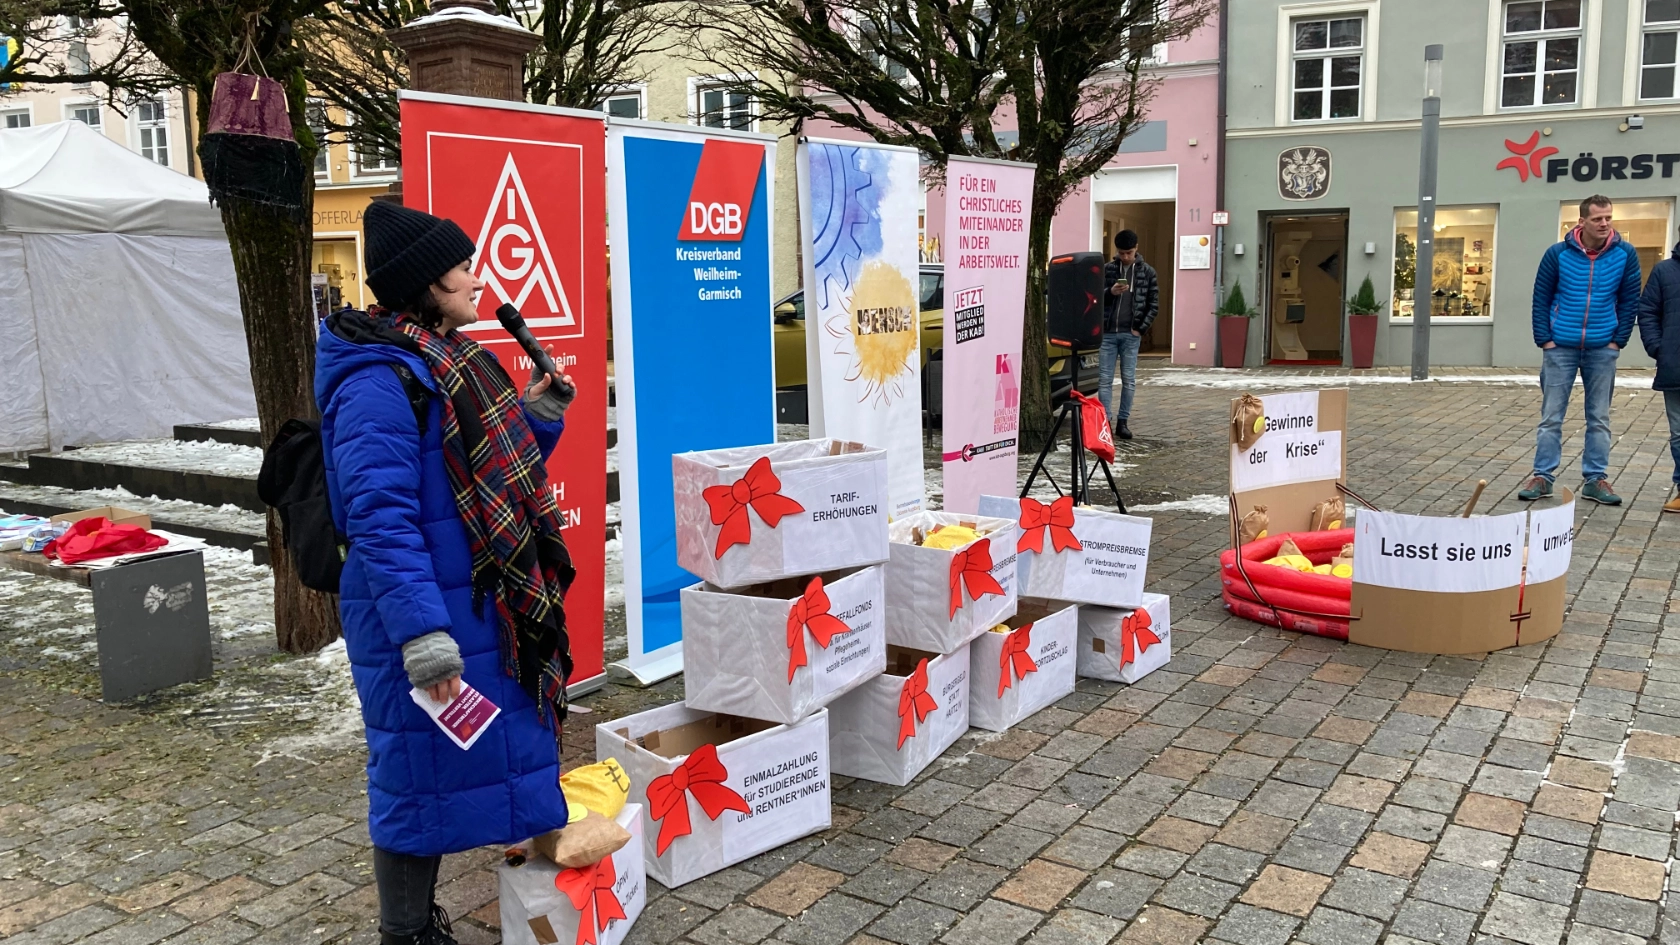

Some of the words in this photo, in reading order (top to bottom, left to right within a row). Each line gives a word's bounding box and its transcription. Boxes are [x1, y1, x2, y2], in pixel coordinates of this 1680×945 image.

[960, 173, 978, 192] FÜR
[981, 178, 996, 193] EIN
[959, 196, 1022, 213] CHRISTLICHES
[690, 201, 742, 235] DGB
[1189, 208, 1200, 222] 11
[959, 216, 1023, 232] MITEINANDER
[959, 235, 969, 250] IN
[971, 236, 990, 250] DER
[676, 246, 741, 261] Kreisverband
[959, 255, 1020, 269] ARBEITSWELT.
[693, 266, 741, 281] Weilheim-
[698, 286, 742, 301] Garmisch
[955, 288, 983, 309] JETZT
[956, 306, 984, 321] MITGLIED
[1249, 448, 1268, 464] der
[830, 491, 860, 505] TARIF-
[813, 504, 878, 522] ERHÖHUNGEN
[1380, 537, 1439, 561] Lasst
[1446, 543, 1476, 561] sie
[1482, 543, 1512, 560] uns
[744, 751, 818, 788] EINMALZAHLUNG
[758, 766, 818, 798] STUDIERENDE
